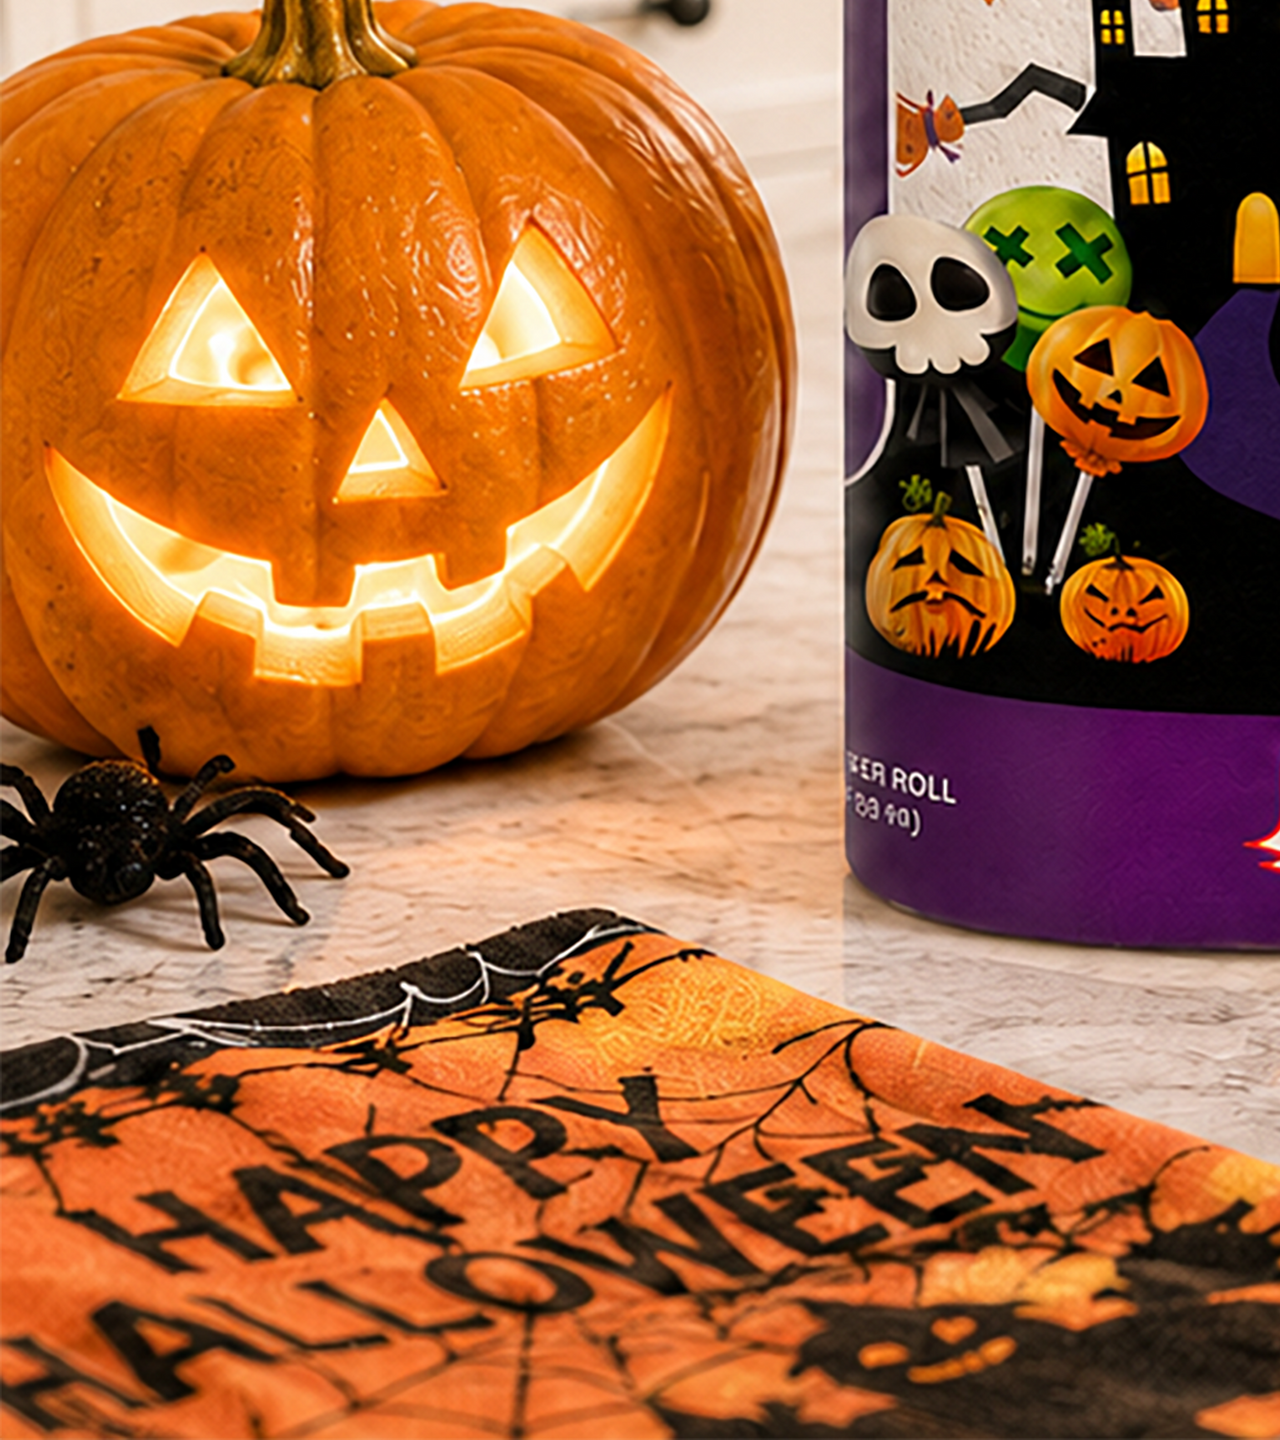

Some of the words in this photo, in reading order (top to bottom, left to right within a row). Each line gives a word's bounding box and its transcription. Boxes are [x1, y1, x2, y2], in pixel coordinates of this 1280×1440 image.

[892, 766, 957, 805] ROLL
[0, 1093, 1106, 1431] HALLOWEEN
[58, 1073, 702, 1275] HAPPY
